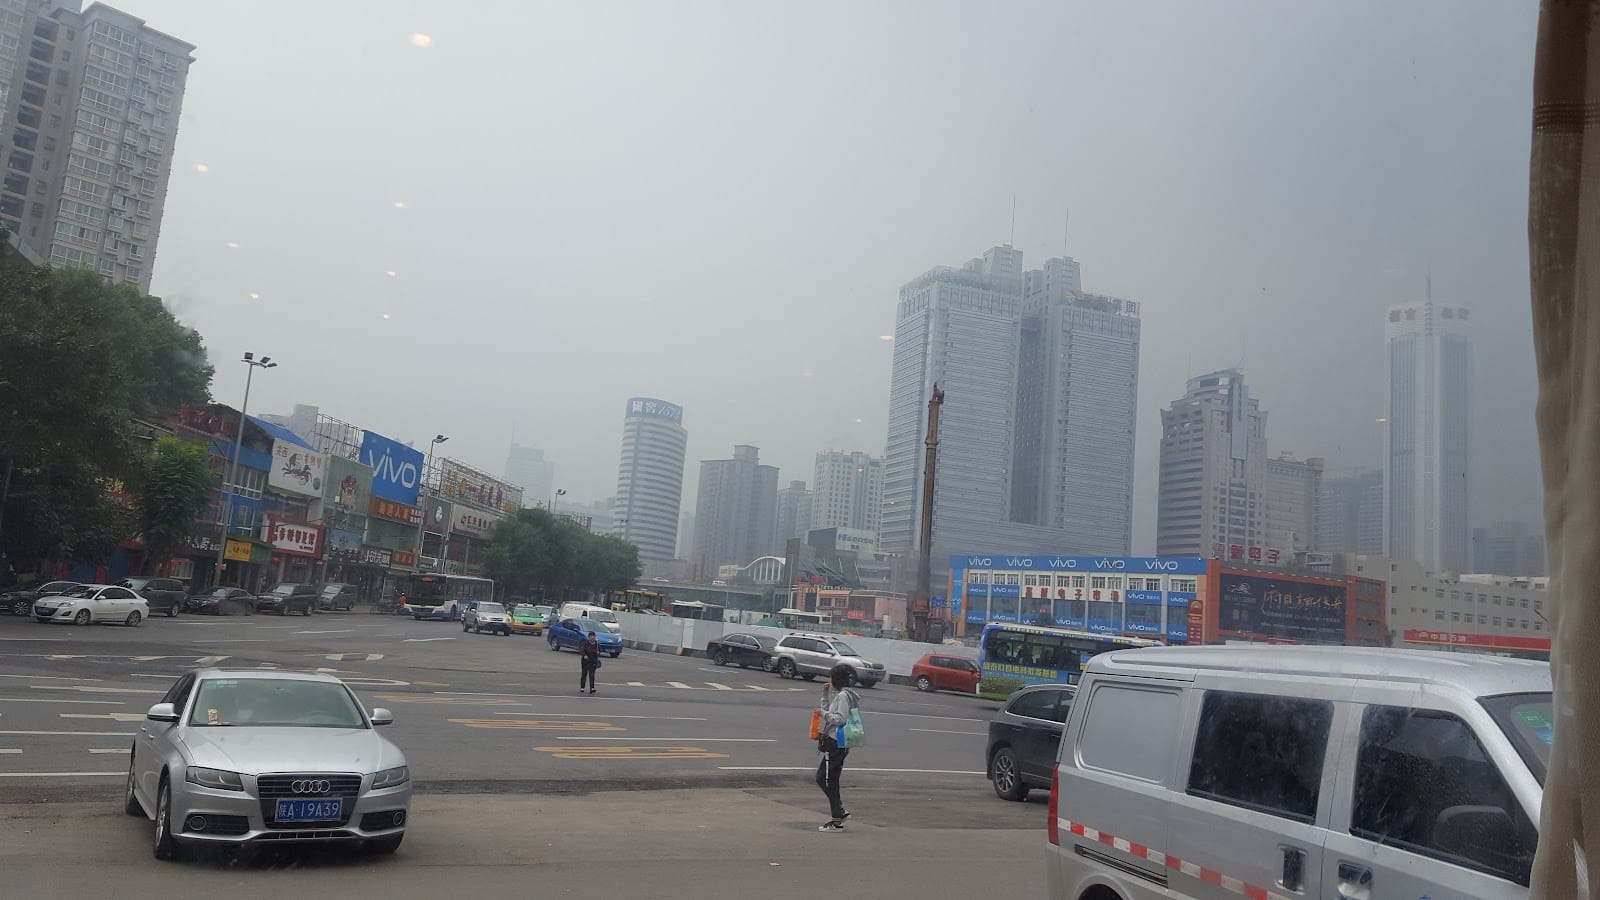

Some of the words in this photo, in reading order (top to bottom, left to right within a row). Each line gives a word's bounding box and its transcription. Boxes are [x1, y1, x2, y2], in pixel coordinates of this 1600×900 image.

[369, 447, 416, 488] vivo
[968, 556, 992, 567] vivo
[1007, 557, 1033, 568] vivo
[1049, 557, 1077, 568] vivo
[1095, 558, 1125, 569] vivo
[1145, 558, 1178, 570] vivo
[1055, 617, 1071, 625] vivo
[1090, 623, 1106, 631] vivo
[1128, 623, 1145, 631] vivo
